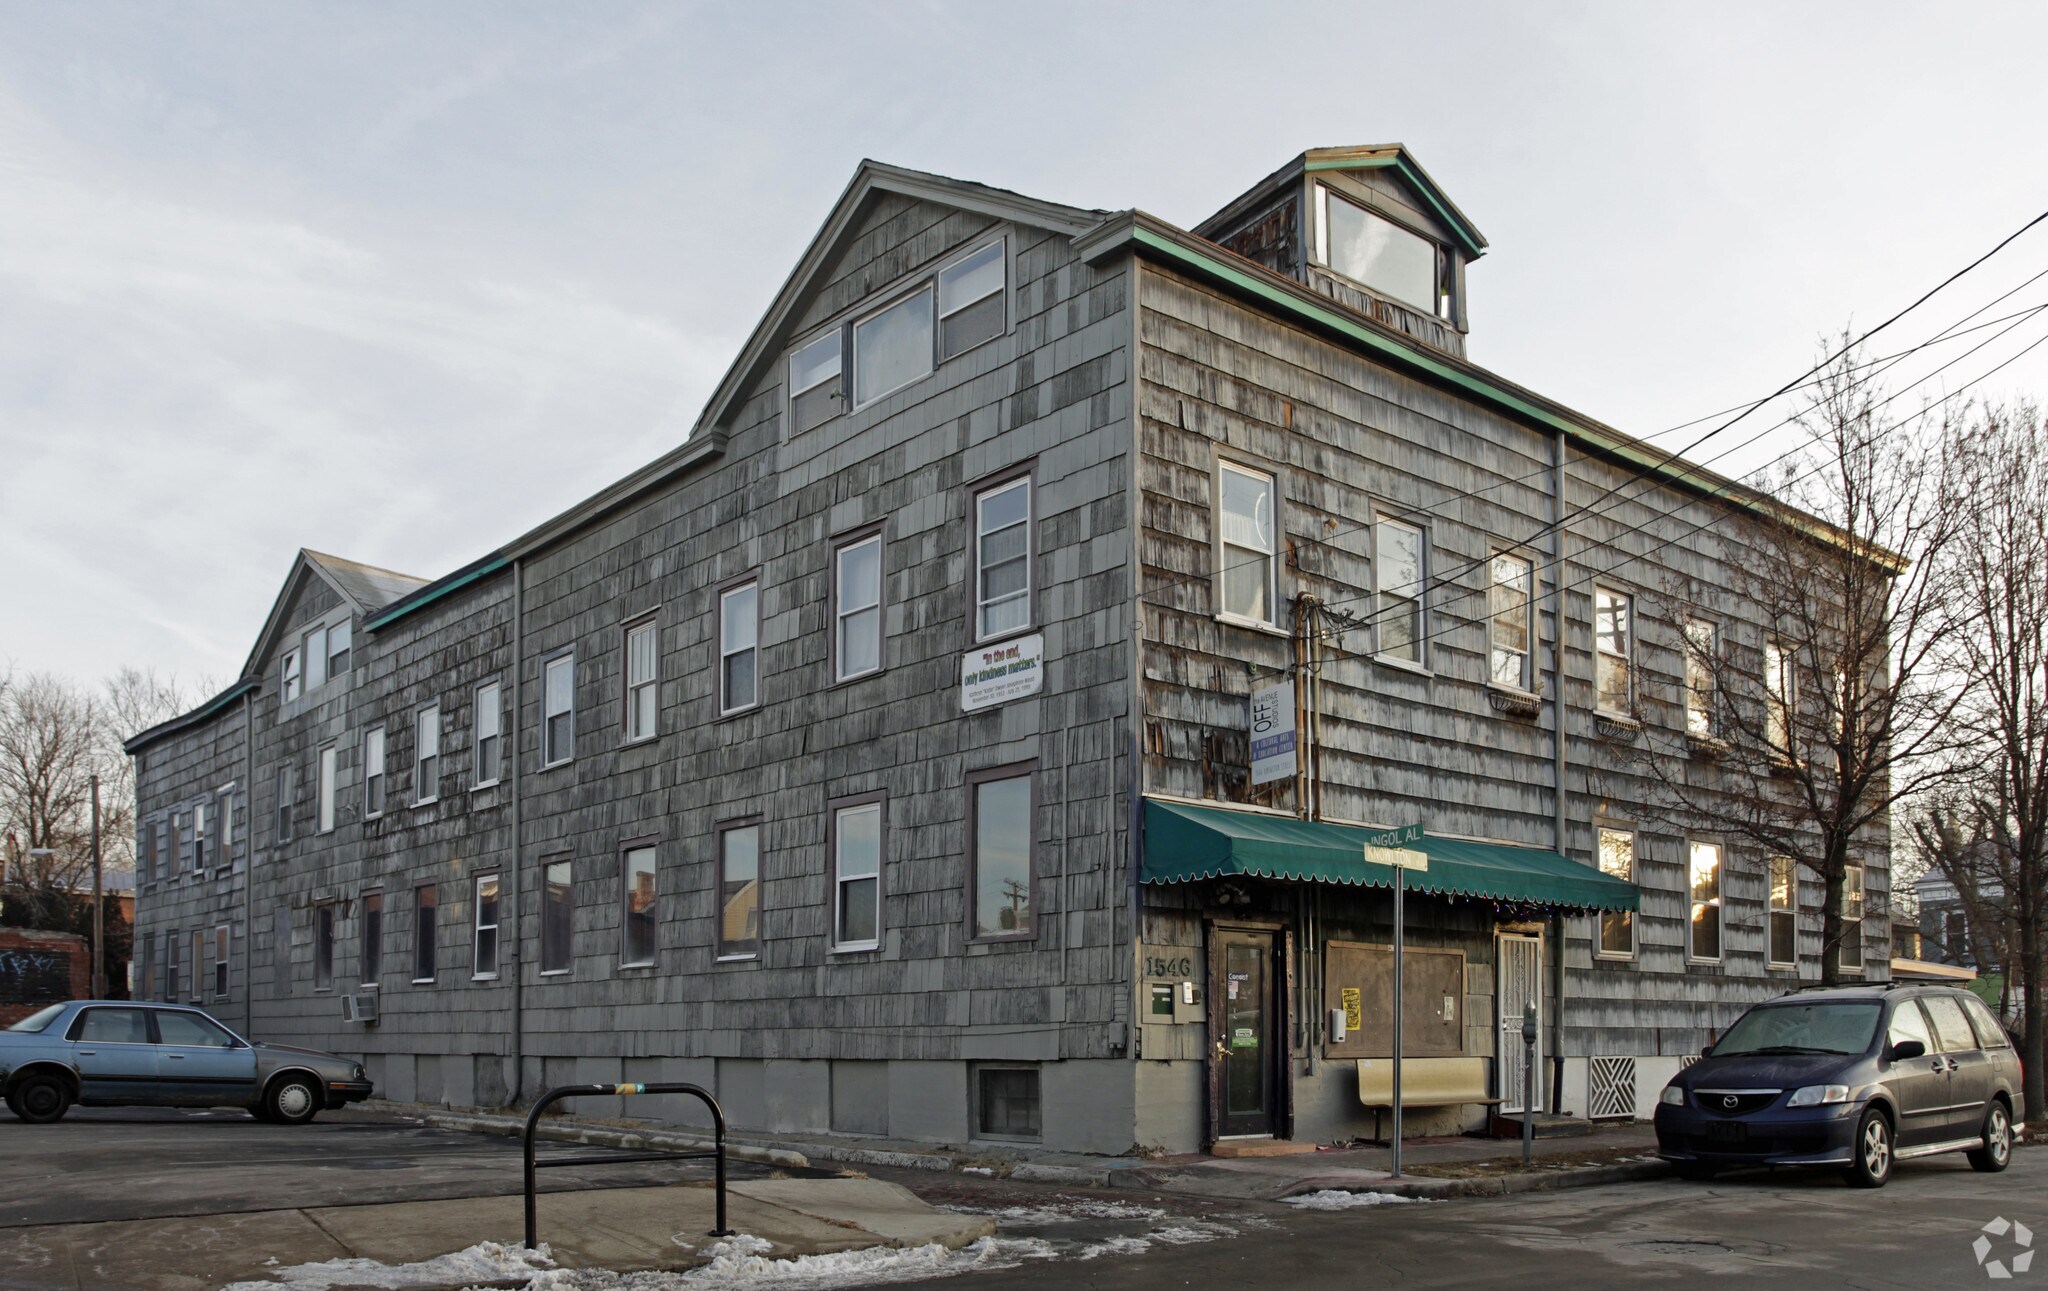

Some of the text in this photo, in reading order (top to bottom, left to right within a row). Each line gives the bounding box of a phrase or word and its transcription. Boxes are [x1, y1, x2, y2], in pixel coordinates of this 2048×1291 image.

[994, 649, 1005, 662] the
[965, 672, 978, 686] only
[979, 665, 1007, 682] kindness
[1260, 690, 1278, 703] AVENUE
[1254, 704, 1272, 733] OFF
[1258, 746, 1278, 759] EDUCATION
[1279, 742, 1293, 753] CENTER
[1371, 827, 1420, 847] INGOL AL
[1367, 845, 1411, 866] KNOWLTON
[1146, 956, 1191, 977] 1546
